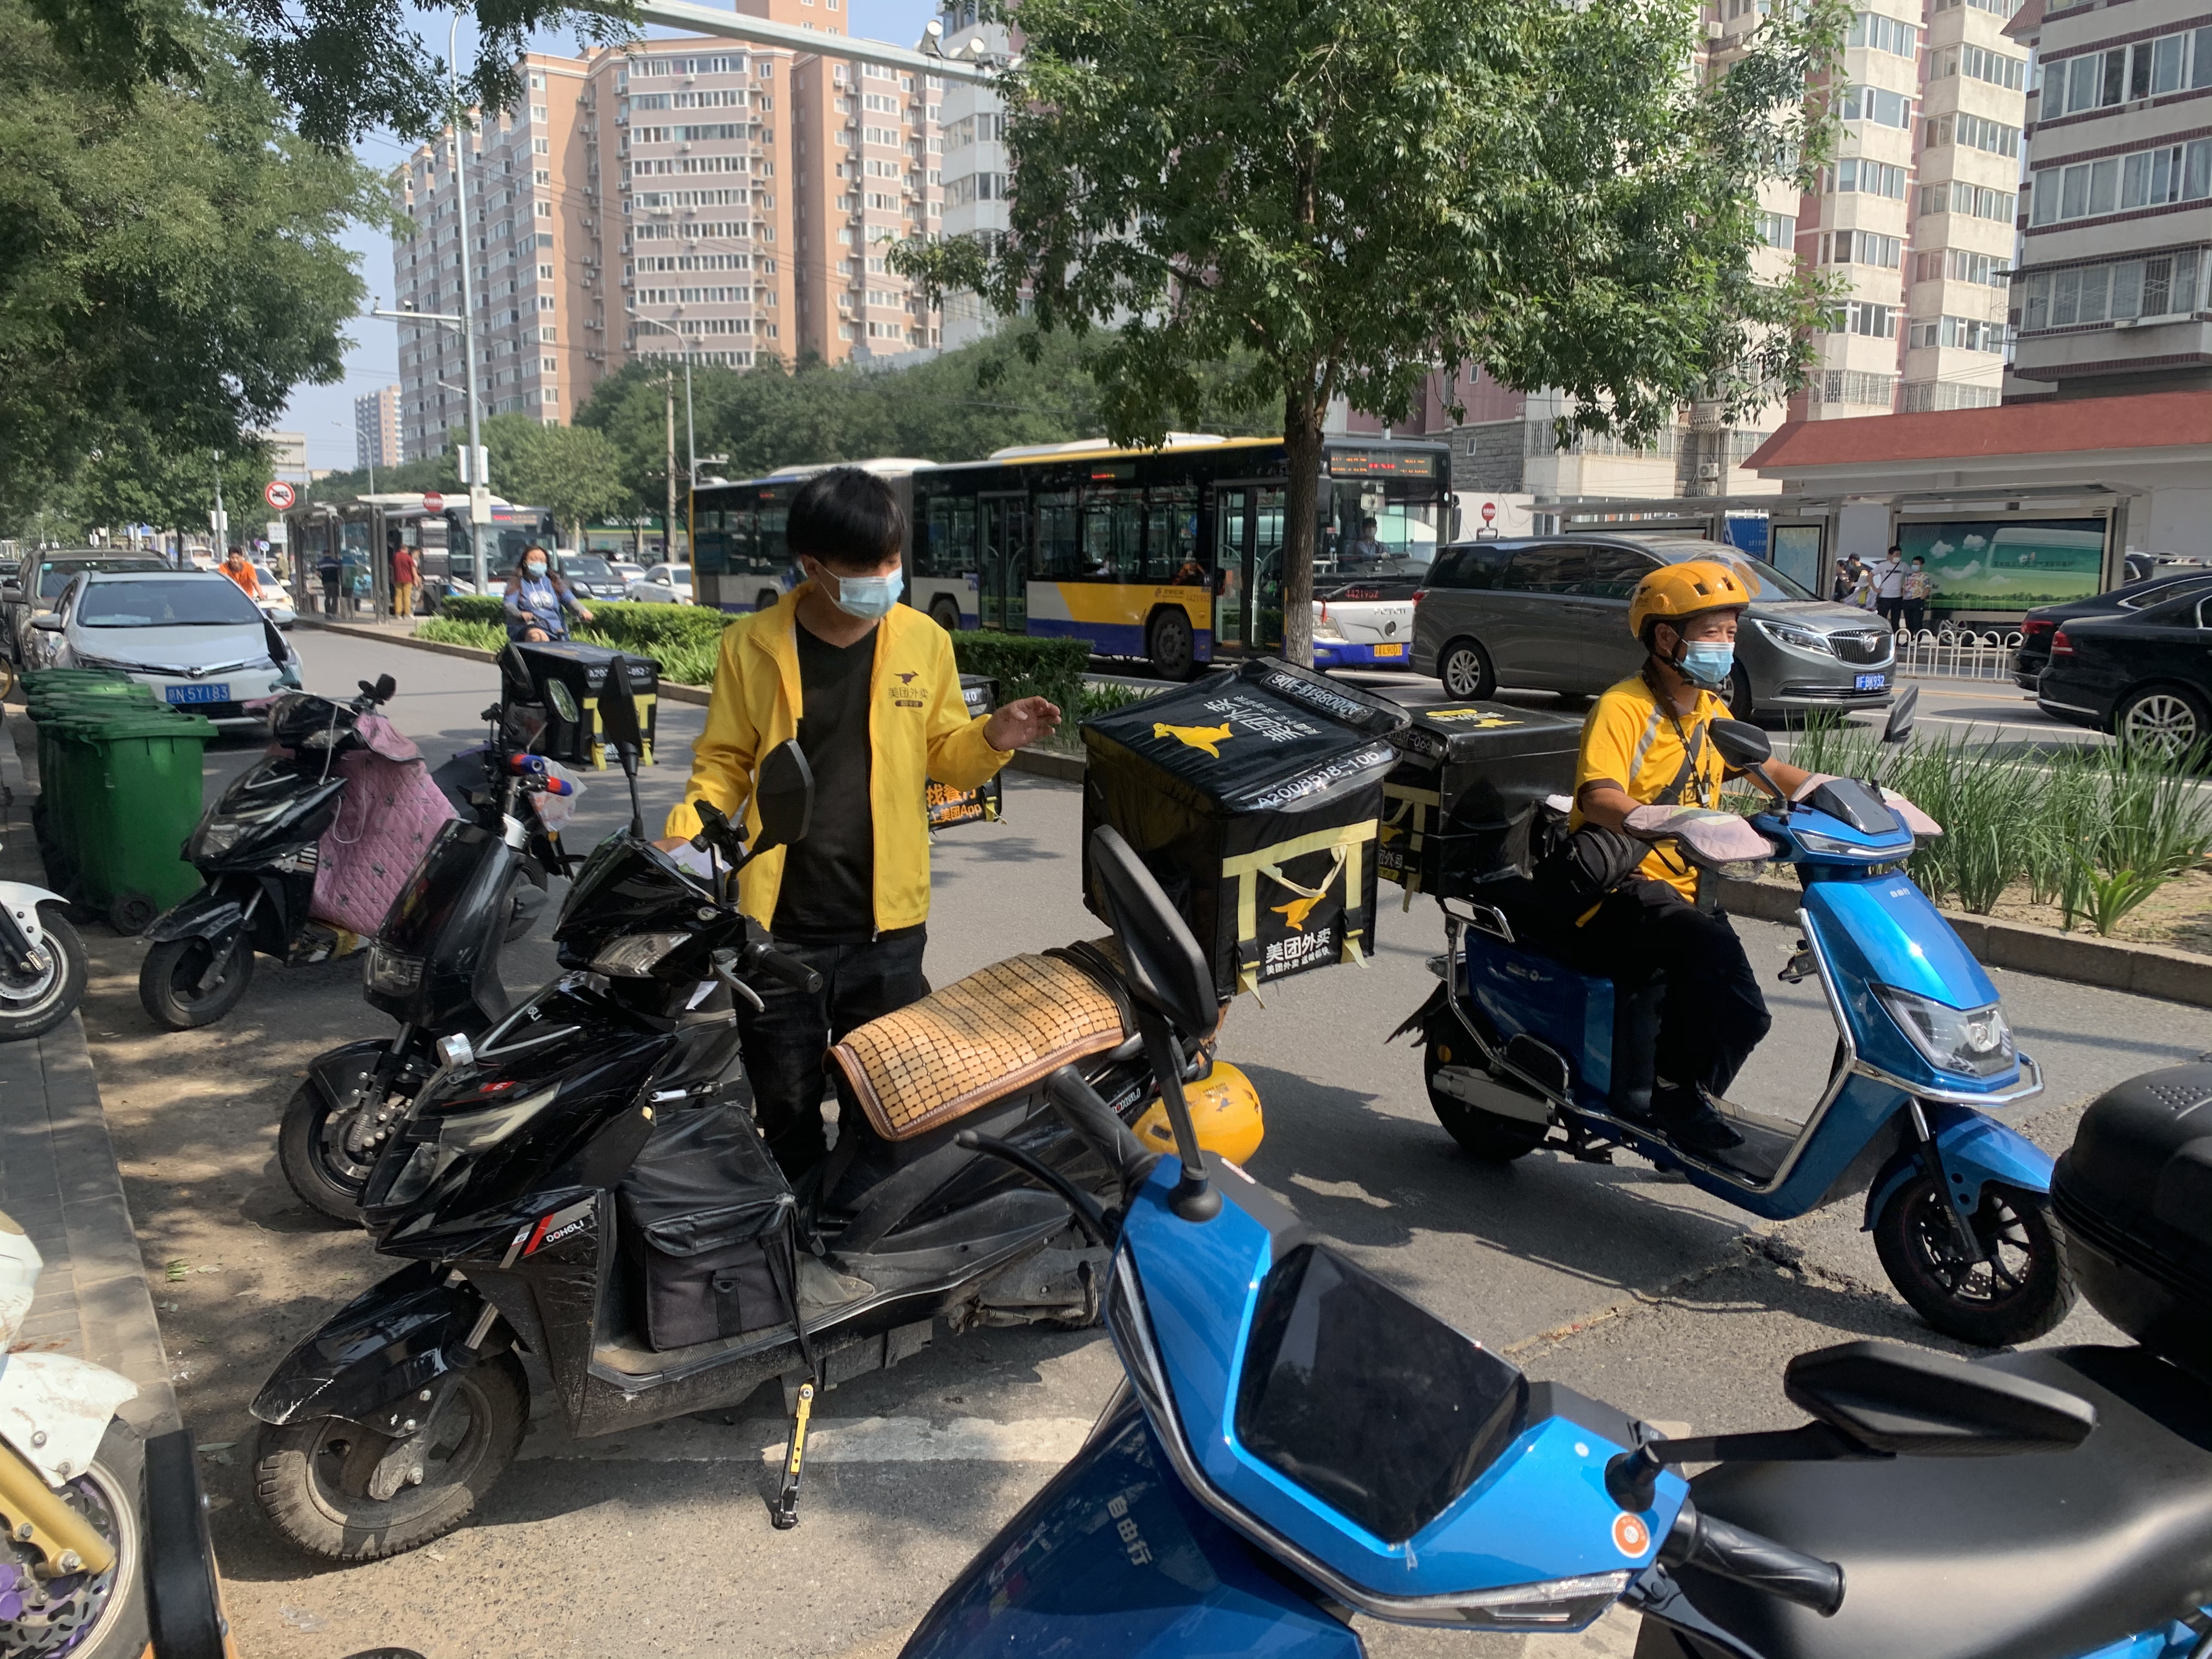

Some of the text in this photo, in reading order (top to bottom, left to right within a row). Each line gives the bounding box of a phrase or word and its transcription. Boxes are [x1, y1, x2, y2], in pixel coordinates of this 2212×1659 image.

[888, 687, 928, 699] 美团外卖
[1203, 697, 1306, 743] 美团外卖
[1257, 751, 1380, 809] A2008518-106
[930, 803, 983, 824] 上美团App
[1265, 927, 1331, 964] 美团外卖
[1107, 1496, 1153, 1566] 自由行
